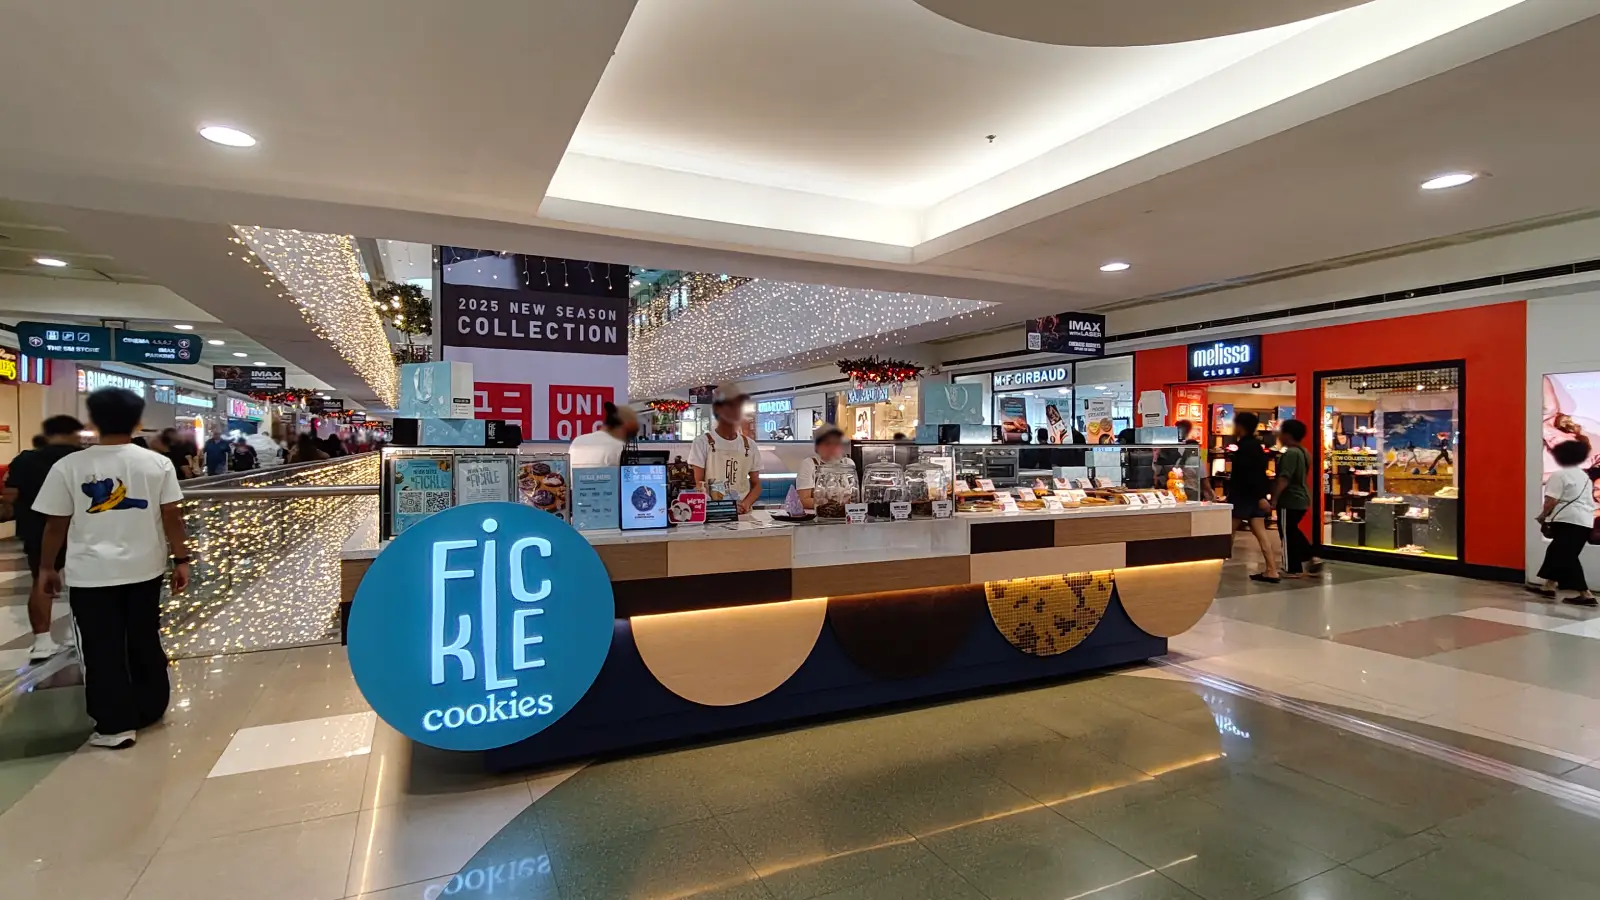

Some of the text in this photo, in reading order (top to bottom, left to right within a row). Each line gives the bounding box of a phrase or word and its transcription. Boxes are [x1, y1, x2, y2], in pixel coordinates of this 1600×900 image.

[458, 297, 617, 321] 2025 NEW SEASON
[457, 315, 618, 344] COLLECTION
[1068, 320, 1102, 333] IMAX
[1193, 342, 1252, 368] melissa
[251, 370, 282, 378] IMAX
[1014, 368, 1067, 385] GIRBAUD
[1202, 367, 1241, 377] CLUBE
[556, 392, 603, 416] UNI
[422, 690, 554, 731] cookies
